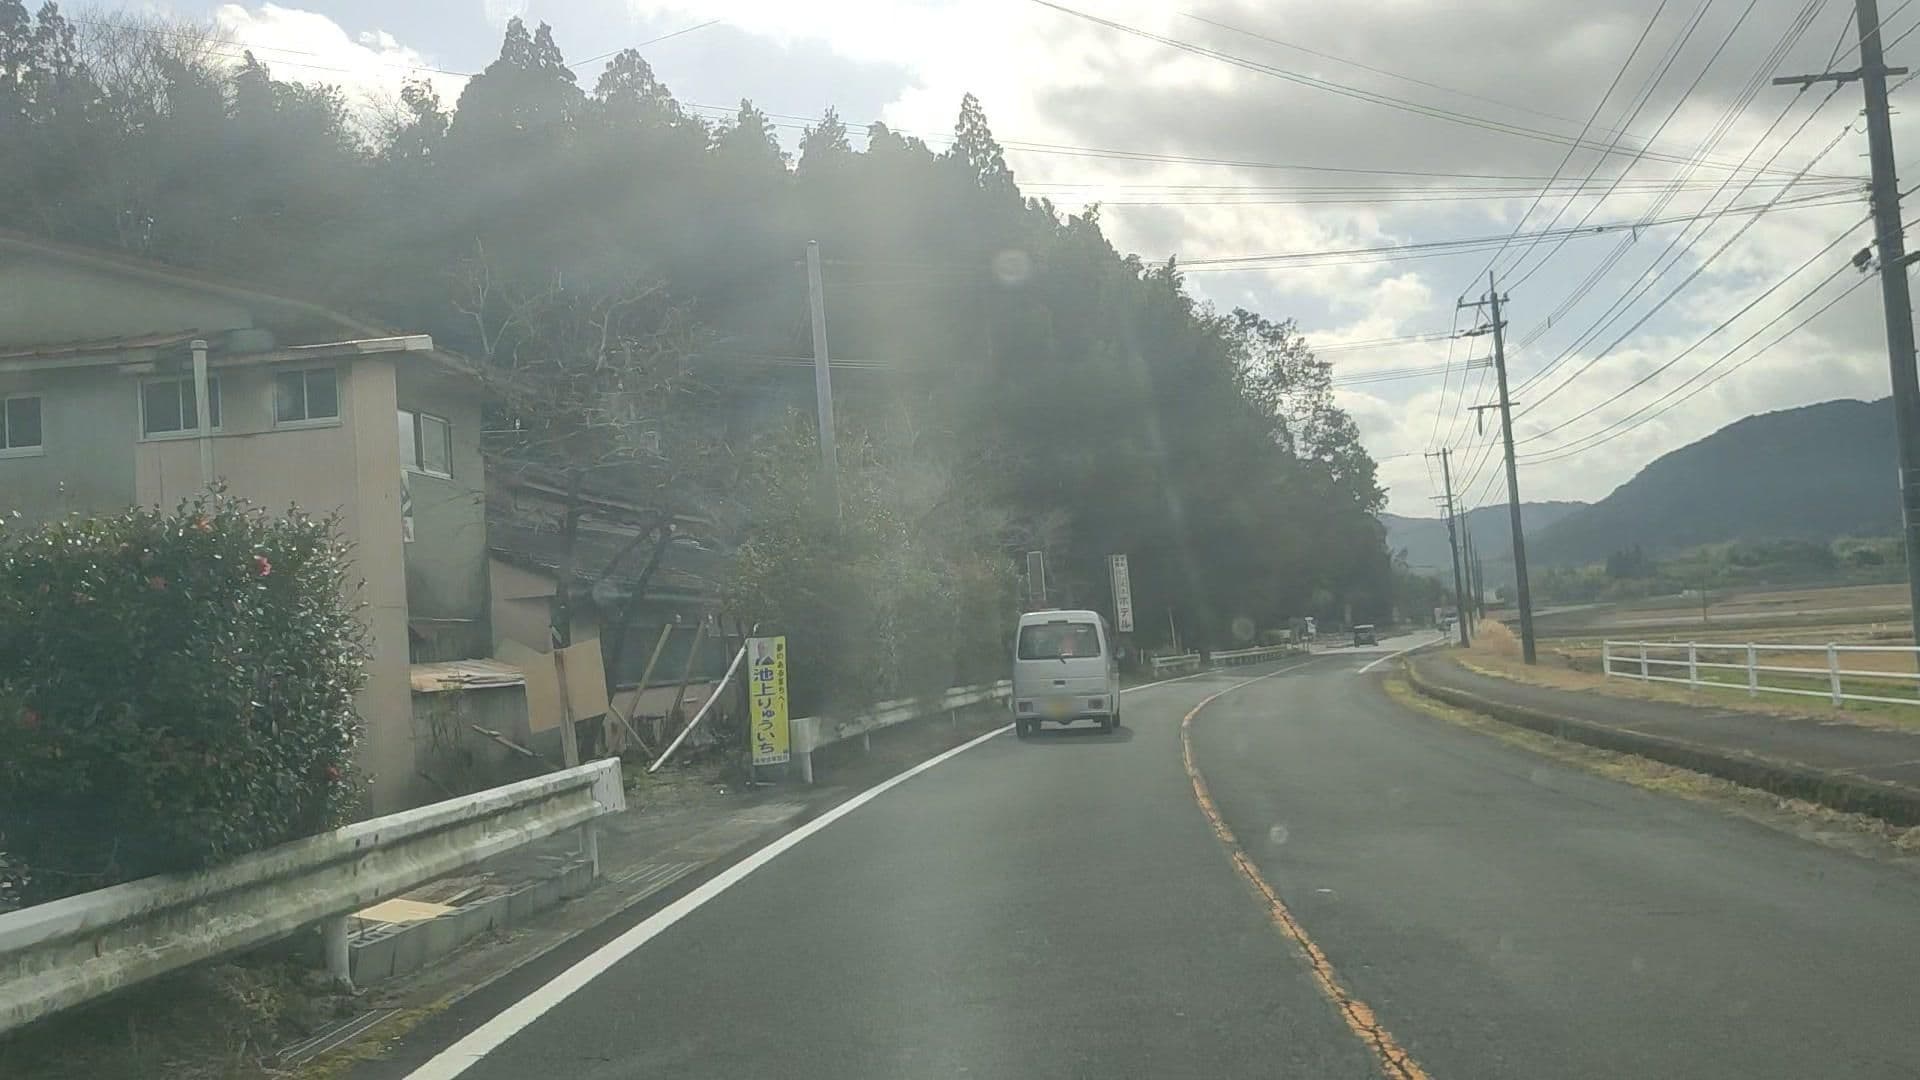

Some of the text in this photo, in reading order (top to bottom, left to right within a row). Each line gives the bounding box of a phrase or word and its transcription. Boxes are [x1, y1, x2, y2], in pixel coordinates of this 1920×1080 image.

[753, 668, 776, 754] 池上りゅういち
